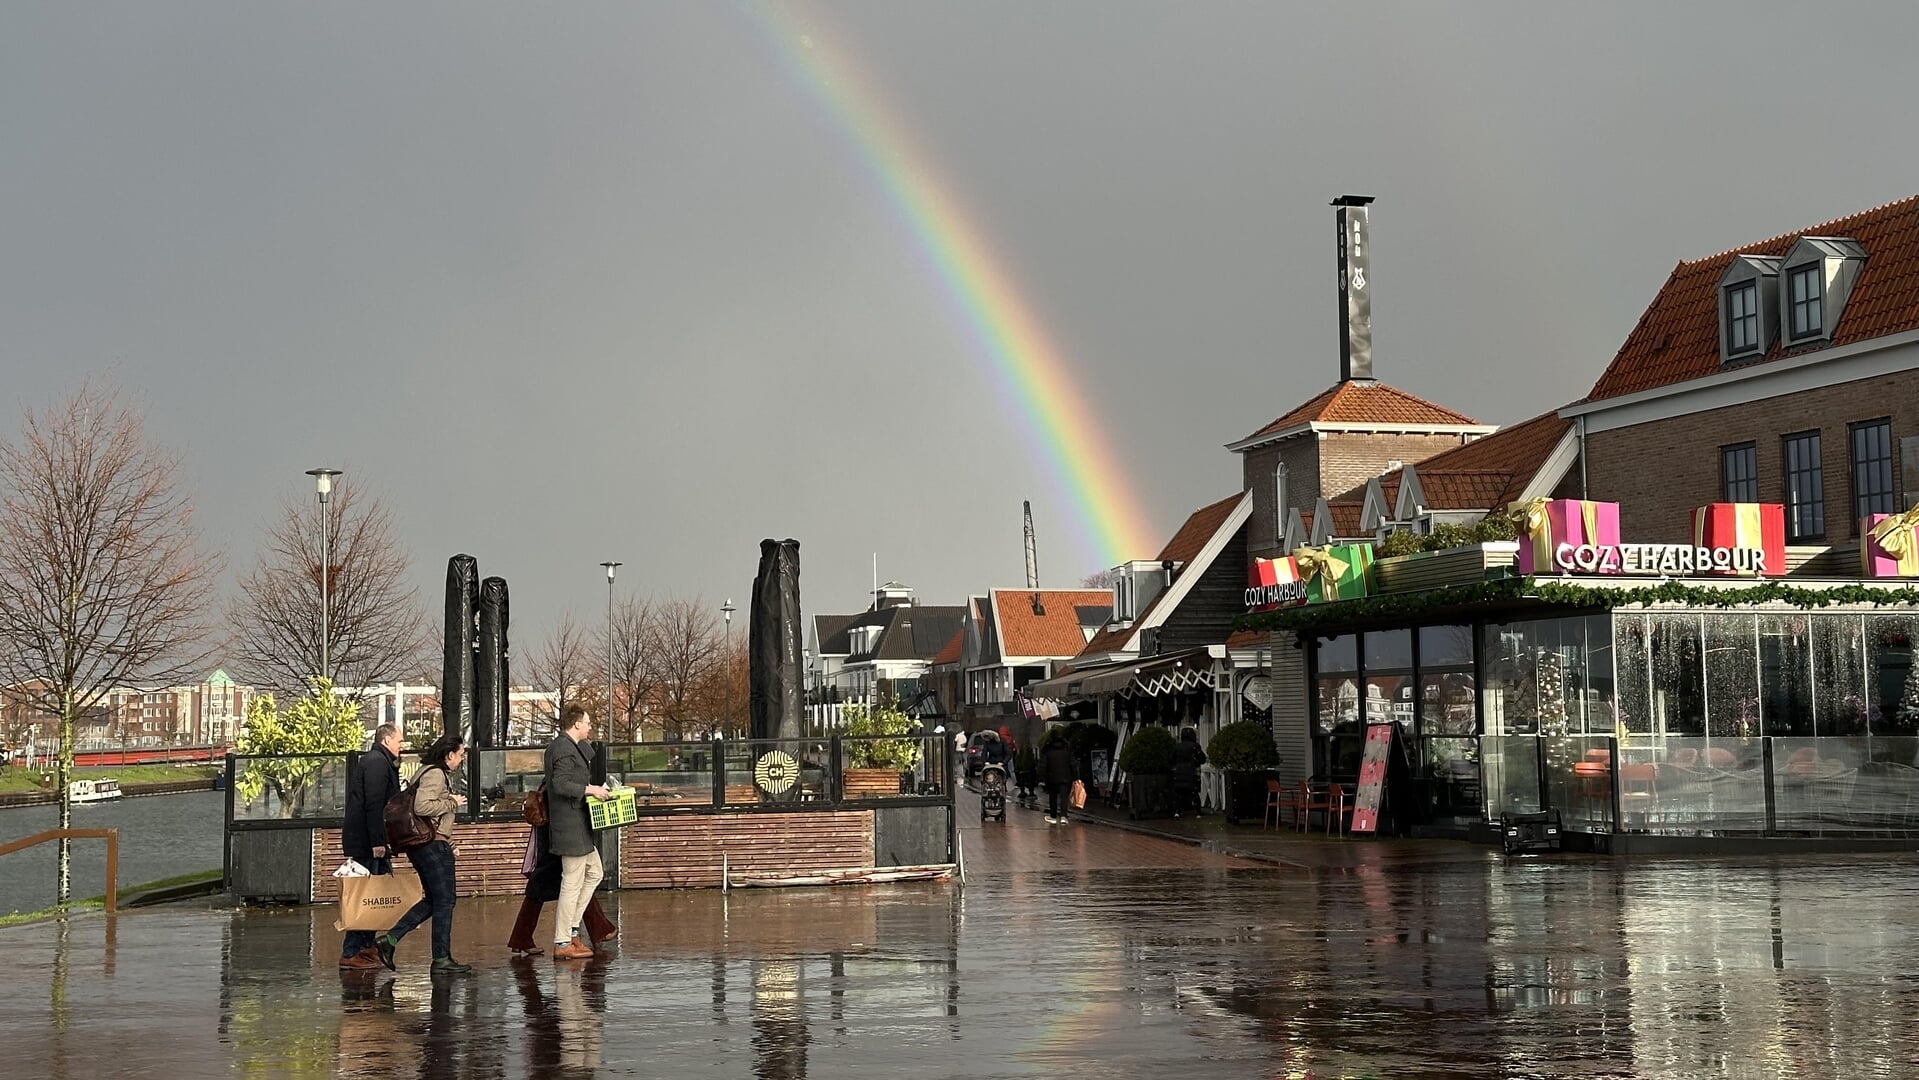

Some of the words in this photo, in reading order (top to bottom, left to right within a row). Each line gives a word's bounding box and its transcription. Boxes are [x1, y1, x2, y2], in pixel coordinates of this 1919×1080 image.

[1555, 542, 1632, 571] COZY
[1640, 544, 1768, 571] HARBOUR
[1244, 586, 1266, 607] COZY
[1267, 580, 1308, 604] HARBOUR
[769, 767, 784, 777] CH
[362, 896, 402, 906] SHABBIES
